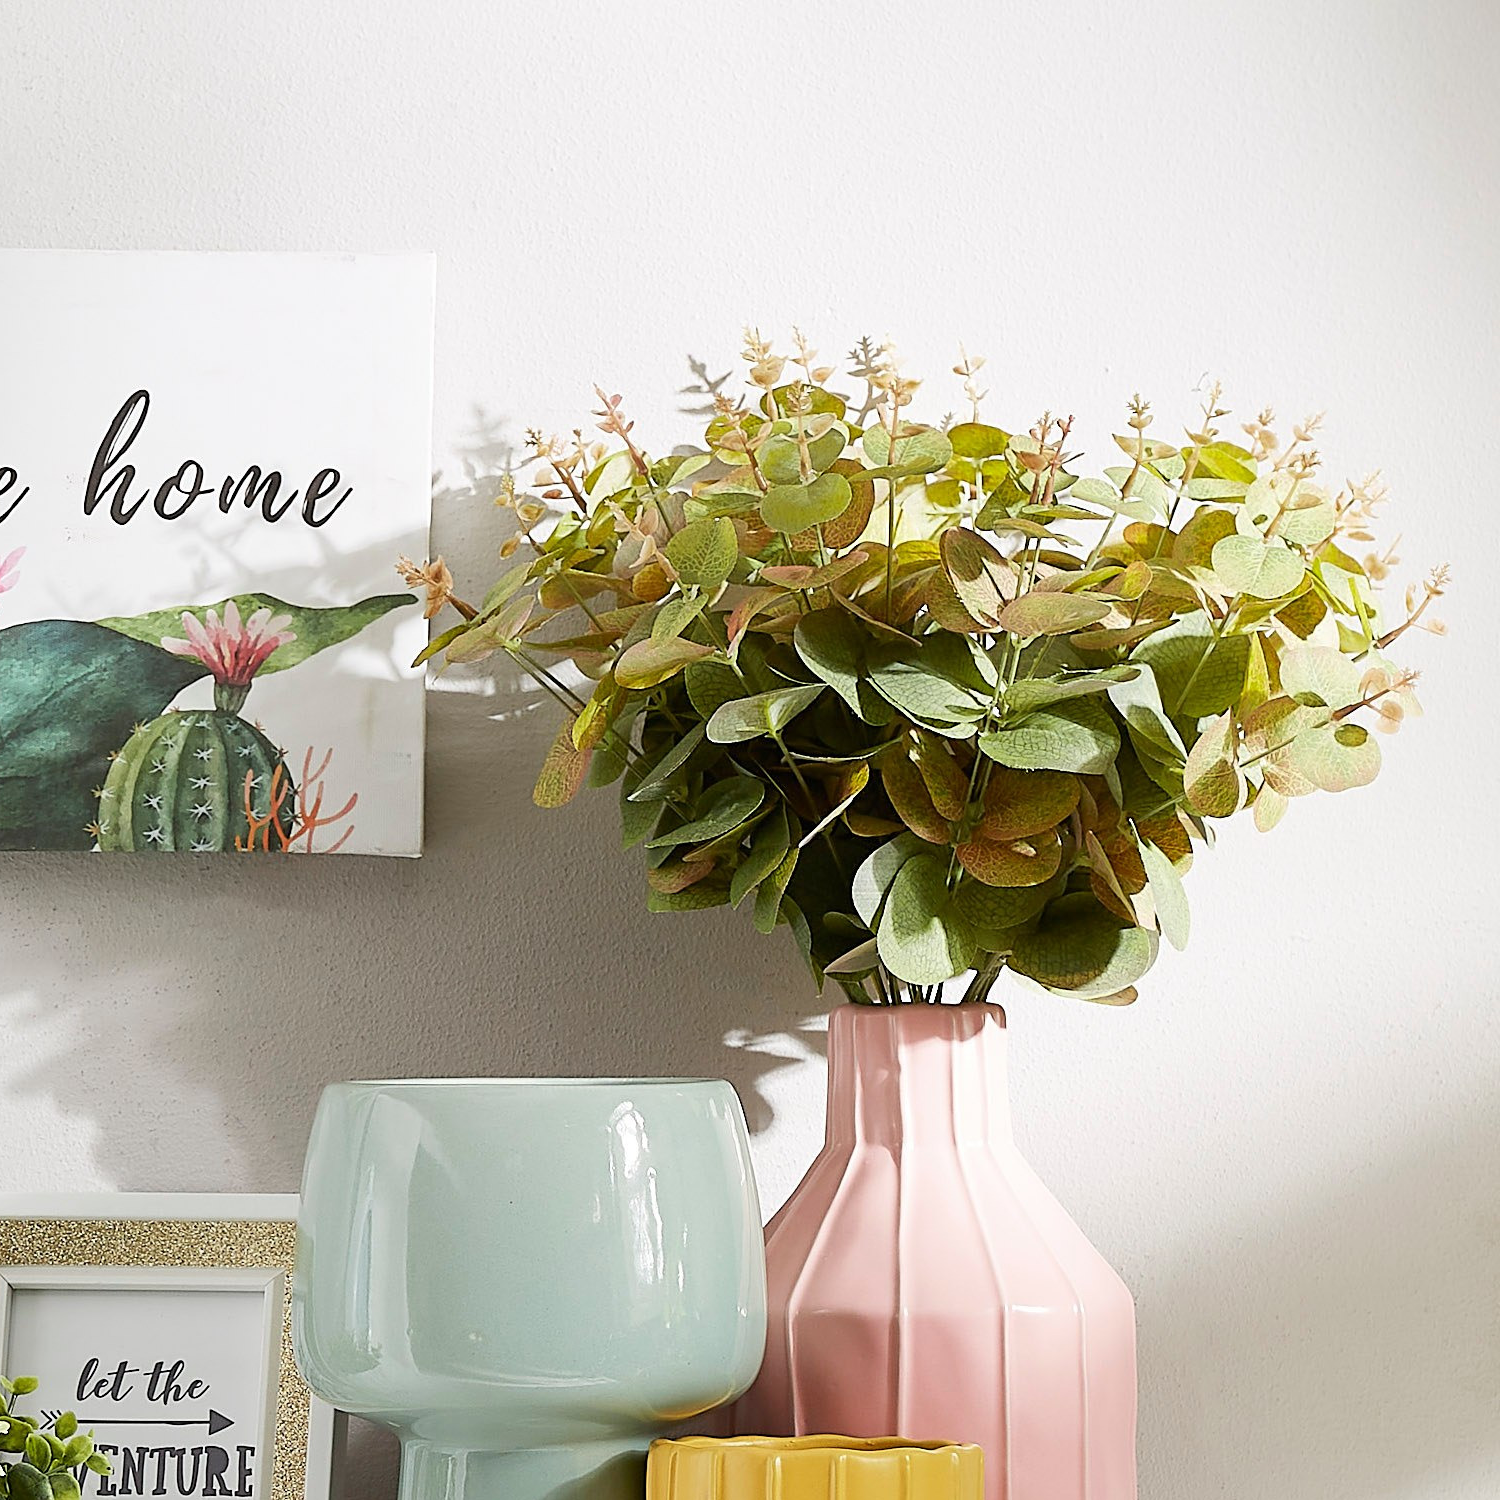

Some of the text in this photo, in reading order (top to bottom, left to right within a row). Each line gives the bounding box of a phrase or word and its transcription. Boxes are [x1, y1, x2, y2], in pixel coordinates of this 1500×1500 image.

[83, 389, 354, 527] home
[76, 1357, 210, 1406] let the
